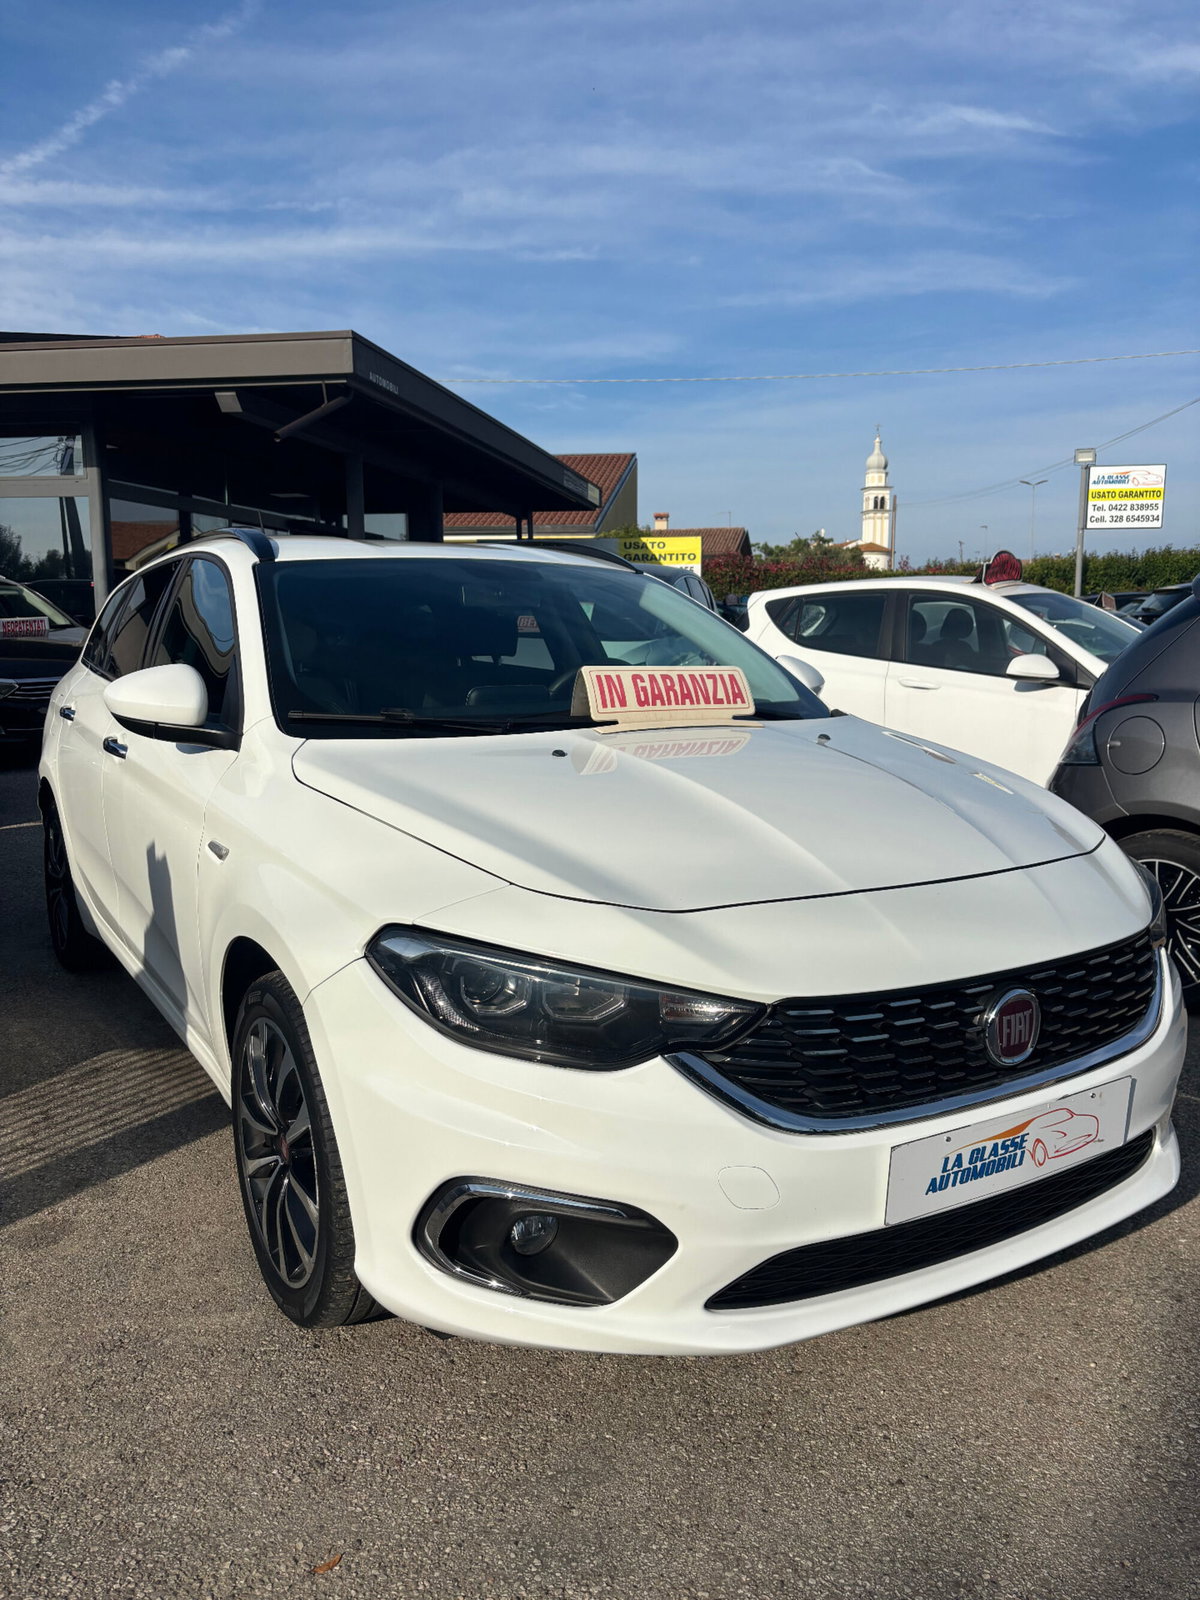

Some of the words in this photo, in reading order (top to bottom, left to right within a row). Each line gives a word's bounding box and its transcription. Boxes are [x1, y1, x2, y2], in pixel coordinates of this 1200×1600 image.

[1091, 491, 1116, 499] USATO
[1118, 490, 1161, 499] GARANTITO
[1092, 504, 1106, 512] Tel.
[1108, 504, 1128, 512] 0422
[1129, 503, 1159, 511] 838955
[1089, 515, 1107, 523] Cell.
[1108, 515, 1124, 523] 328
[1125, 515, 1160, 523] 6545934
[623, 541, 666, 550] USATO
[622, 552, 697, 562] GARANTITO
[595, 674, 628, 709] IN
[631, 674, 746, 707] GARANZIA
[1002, 1008, 1032, 1048] FIAT
[941, 1154, 963, 1173] LA
[925, 1150, 1026, 1195] AUTOMOBILI
